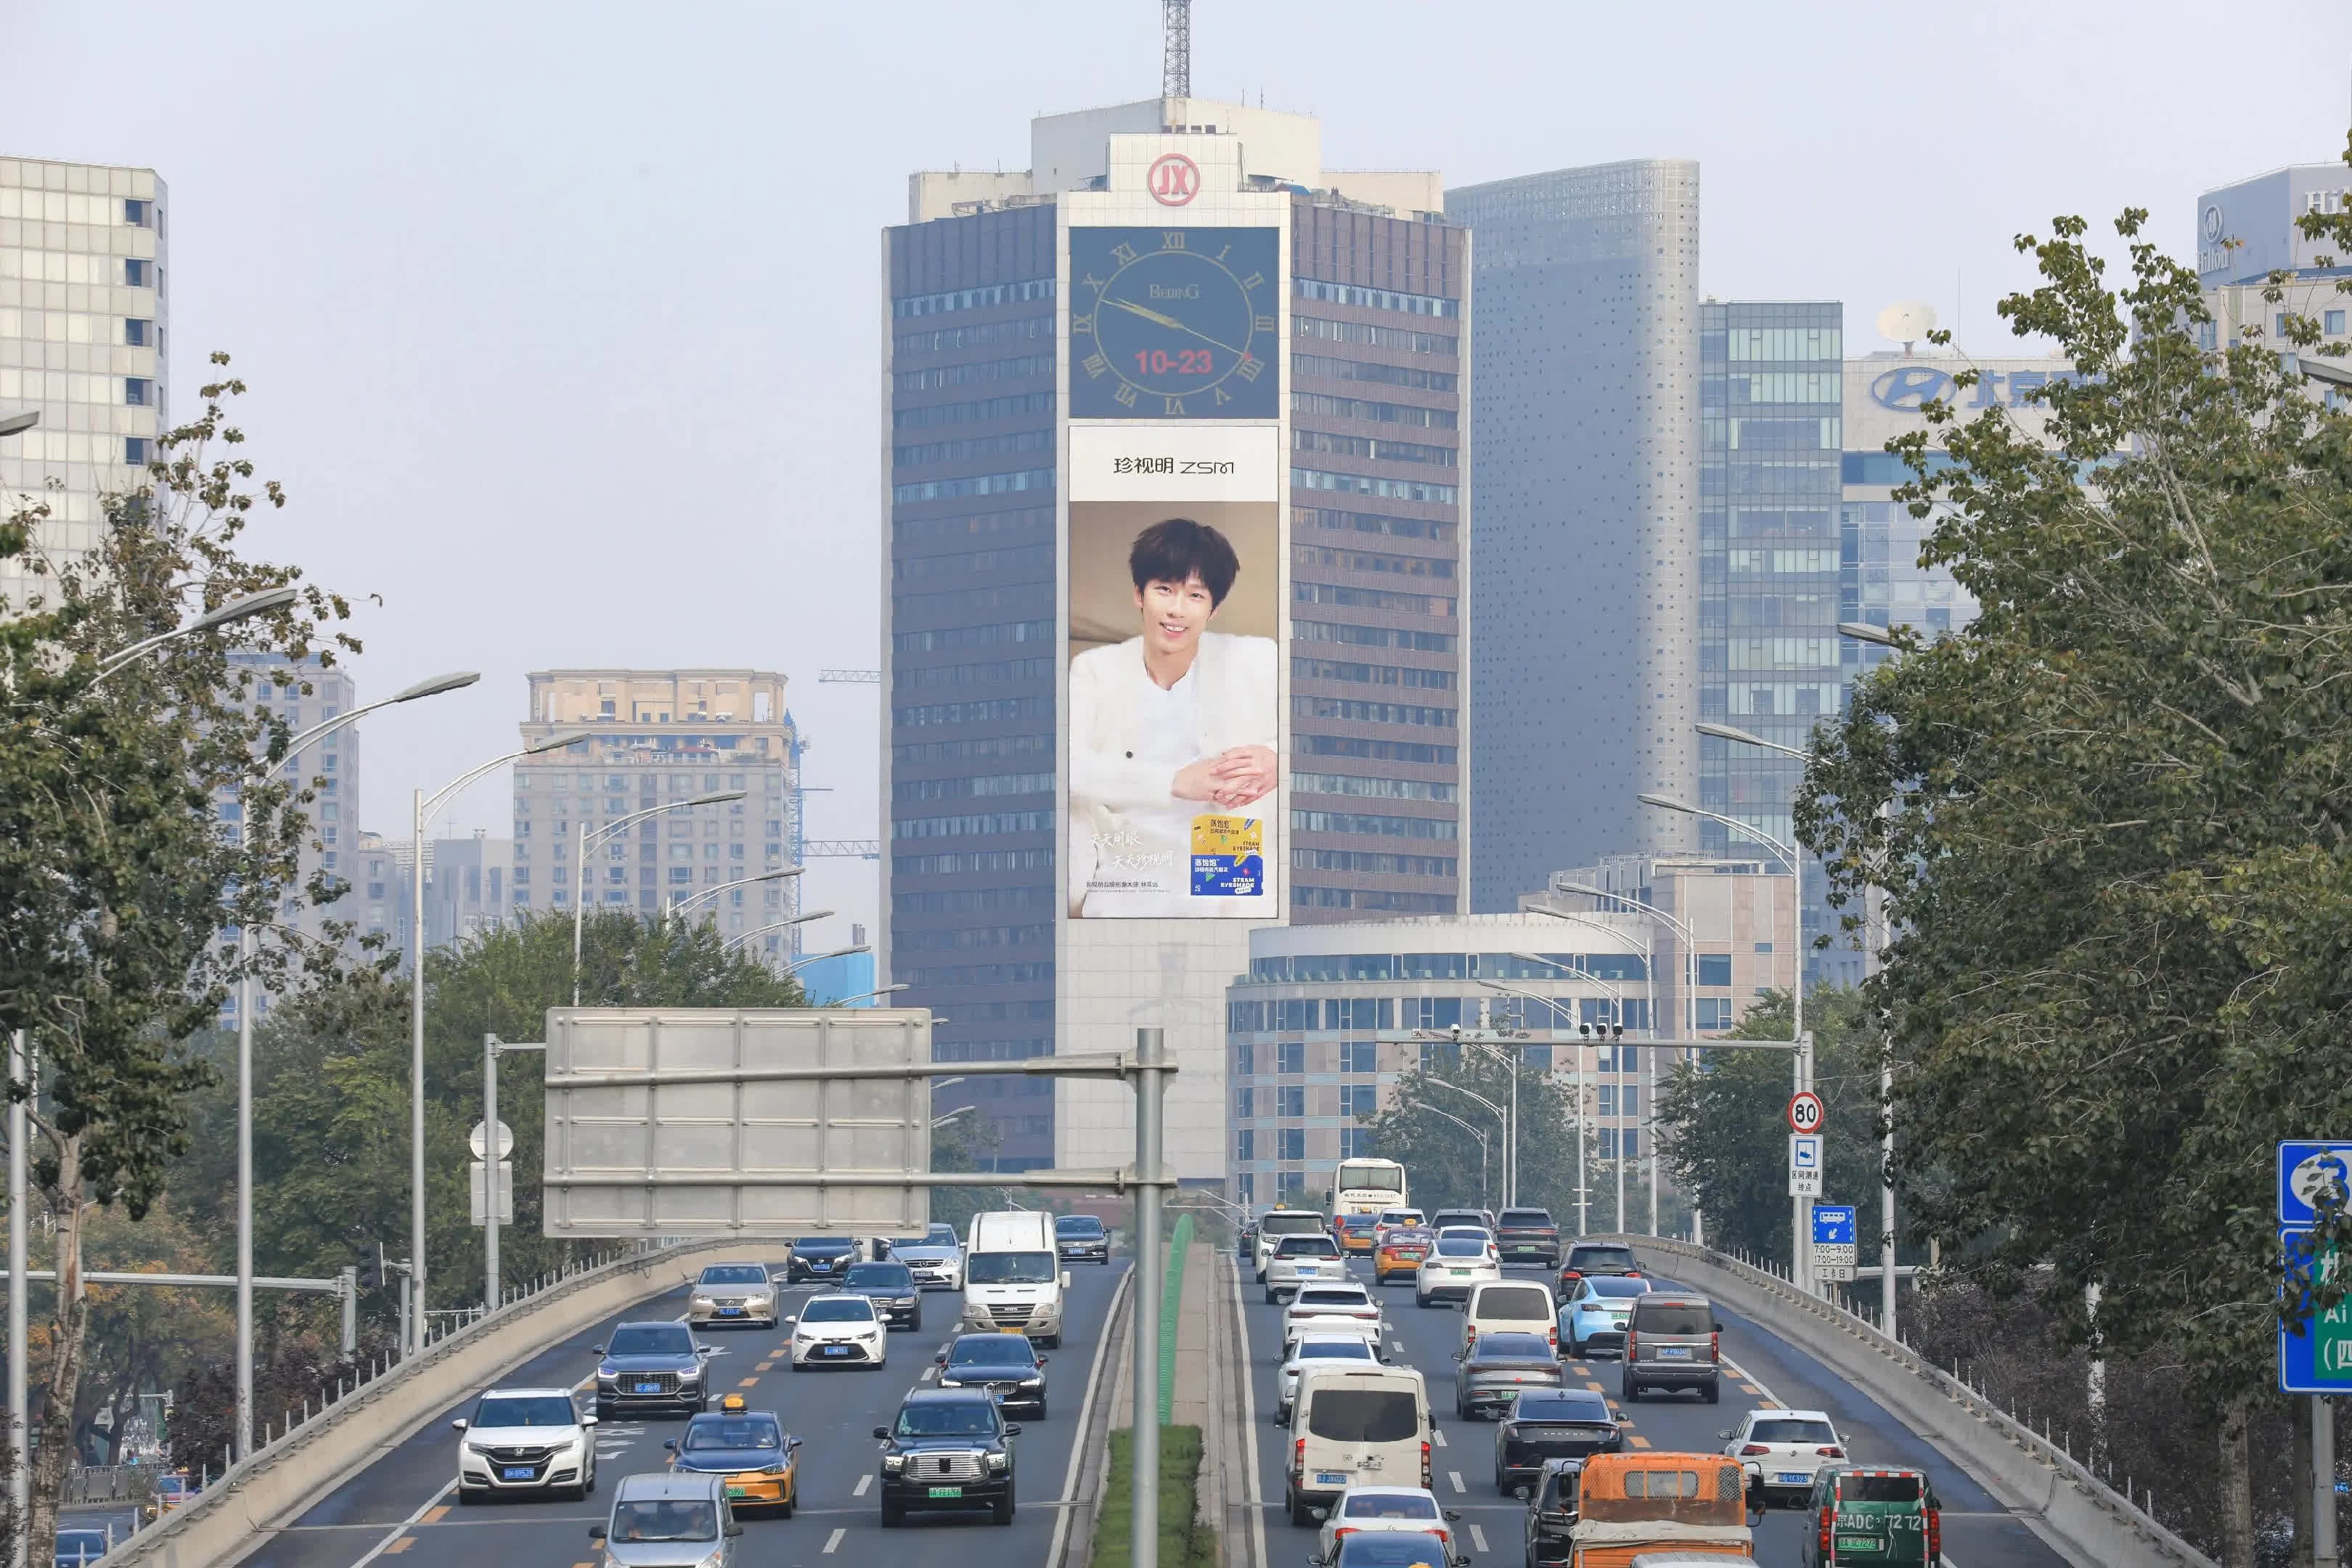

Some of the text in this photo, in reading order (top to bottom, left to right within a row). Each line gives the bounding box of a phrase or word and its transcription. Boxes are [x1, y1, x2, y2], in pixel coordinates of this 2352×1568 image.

[1162, 232, 1185, 249] XII
[1135, 350, 1212, 374] 10-23
[1114, 457, 1173, 474] 珍视明
[1795, 1104, 1816, 1123] 80
[1792, 1170, 1818, 1180] 区间测速
[1798, 1183, 1811, 1191] 终点
[1823, 1269, 1845, 1278] 工作日
